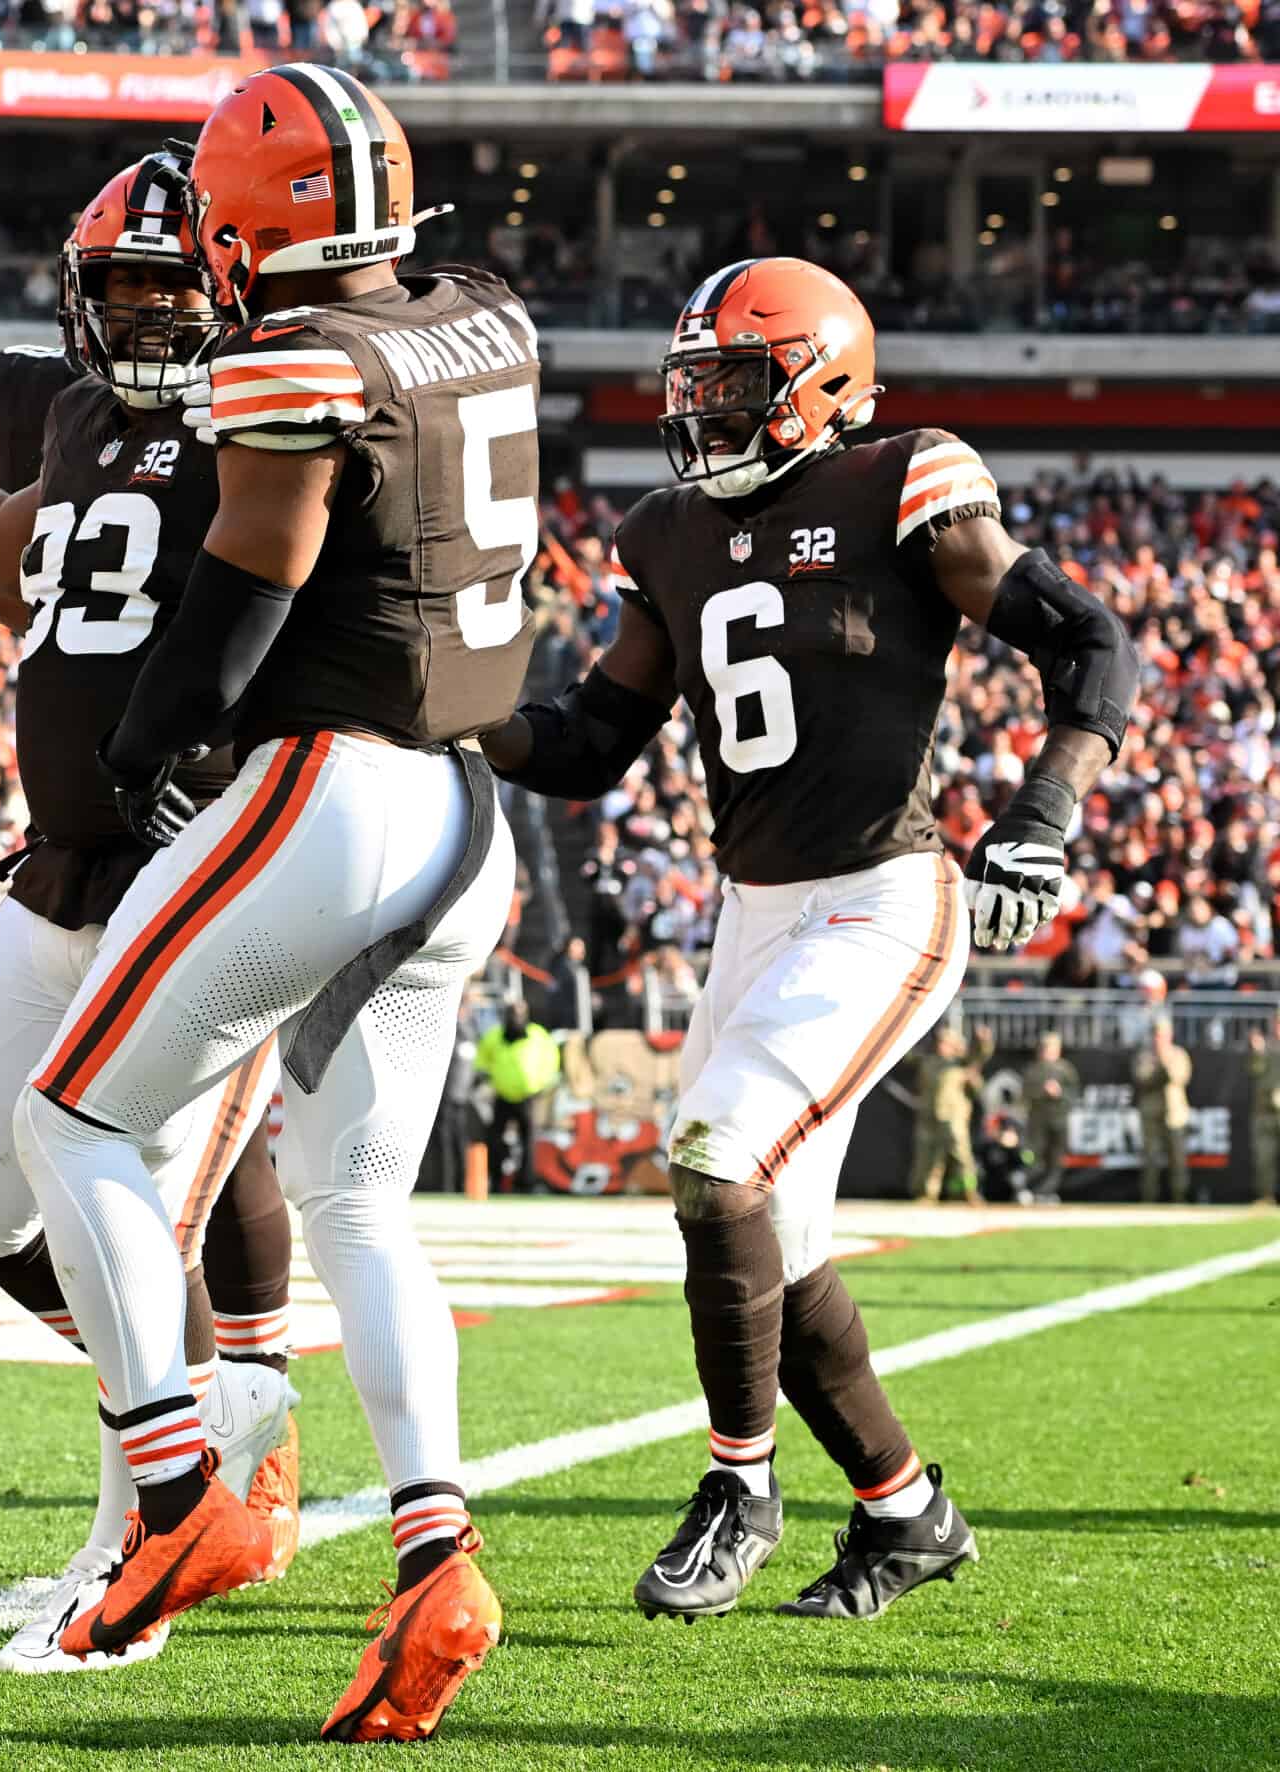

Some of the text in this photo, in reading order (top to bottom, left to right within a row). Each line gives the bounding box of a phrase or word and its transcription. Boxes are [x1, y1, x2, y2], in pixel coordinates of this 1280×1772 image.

[367, 309, 527, 390] WALKER
[134, 440, 180, 476] 32
[457, 384, 538, 650] 5
[18, 492, 162, 662] 93
[789, 526, 835, 564] 32
[701, 581, 797, 774] 6
